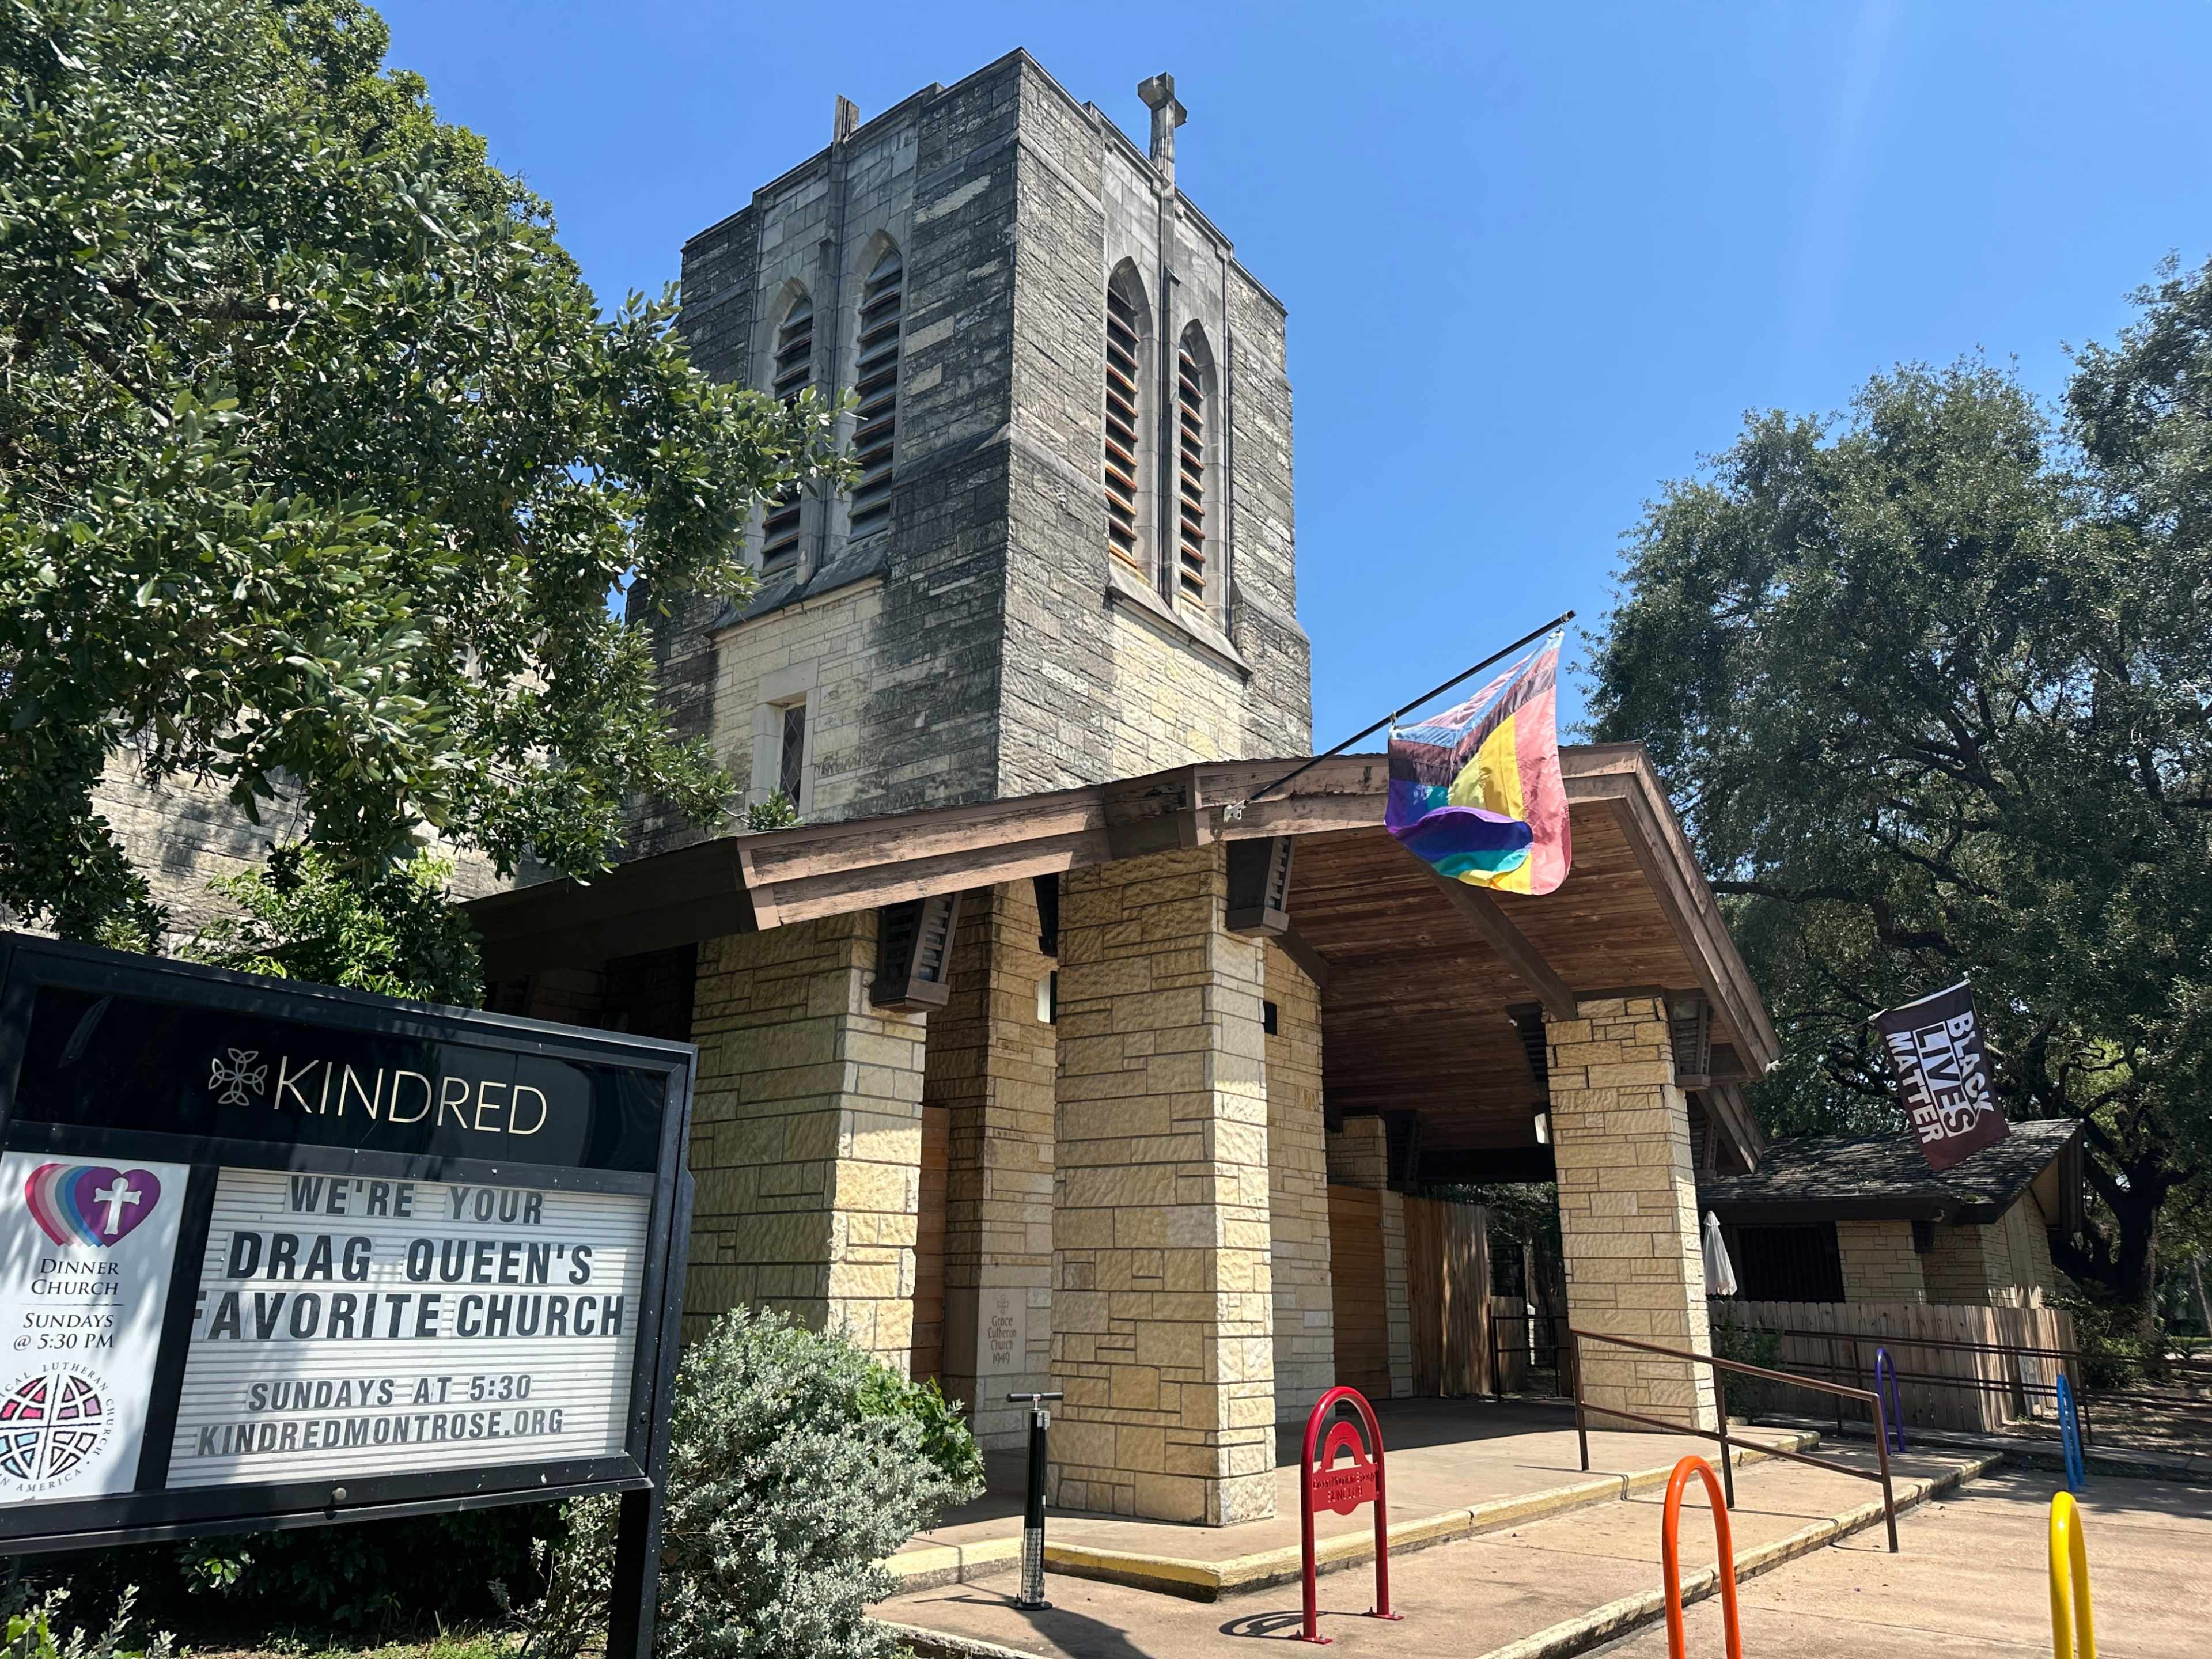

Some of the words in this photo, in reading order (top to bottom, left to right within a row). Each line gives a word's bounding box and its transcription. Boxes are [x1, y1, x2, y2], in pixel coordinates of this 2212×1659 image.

[1914, 1023, 1975, 1135] LIVES
[1947, 1010, 1995, 1120] BLACK
[274, 1056, 547, 1135] KINDRED
[1886, 1031, 1945, 1143] MATTER
[291, 1176, 414, 1217] WE'RE
[450, 1187, 543, 1224] YOUR
[40, 1258, 119, 1275] DINNER
[226, 1231, 372, 1282] DRAG
[406, 1238, 592, 1285] QUEEN'S
[31, 1279, 119, 1295] CHURCH
[23, 1312, 114, 1328] SUNDAYS
[457, 1294, 624, 1338] CHURCH
[991, 1315, 1013, 1327] Grace
[14, 1335, 31, 1351] @
[37, 1334, 77, 1349] 5:30
[84, 1333, 115, 1349] PM
[991, 1339, 1014, 1351] Church
[43, 1362, 108, 1392] LUTHERAN
[248, 1378, 395, 1411] SUNDAYS
[414, 1377, 452, 1403] AT
[470, 1374, 532, 1401] 5:30
[93, 1398, 115, 1455] CHURCH
[198, 1409, 563, 1456] KINDREDMONTROSE.ORG
[16, 1469, 81, 1492] AMERICA
